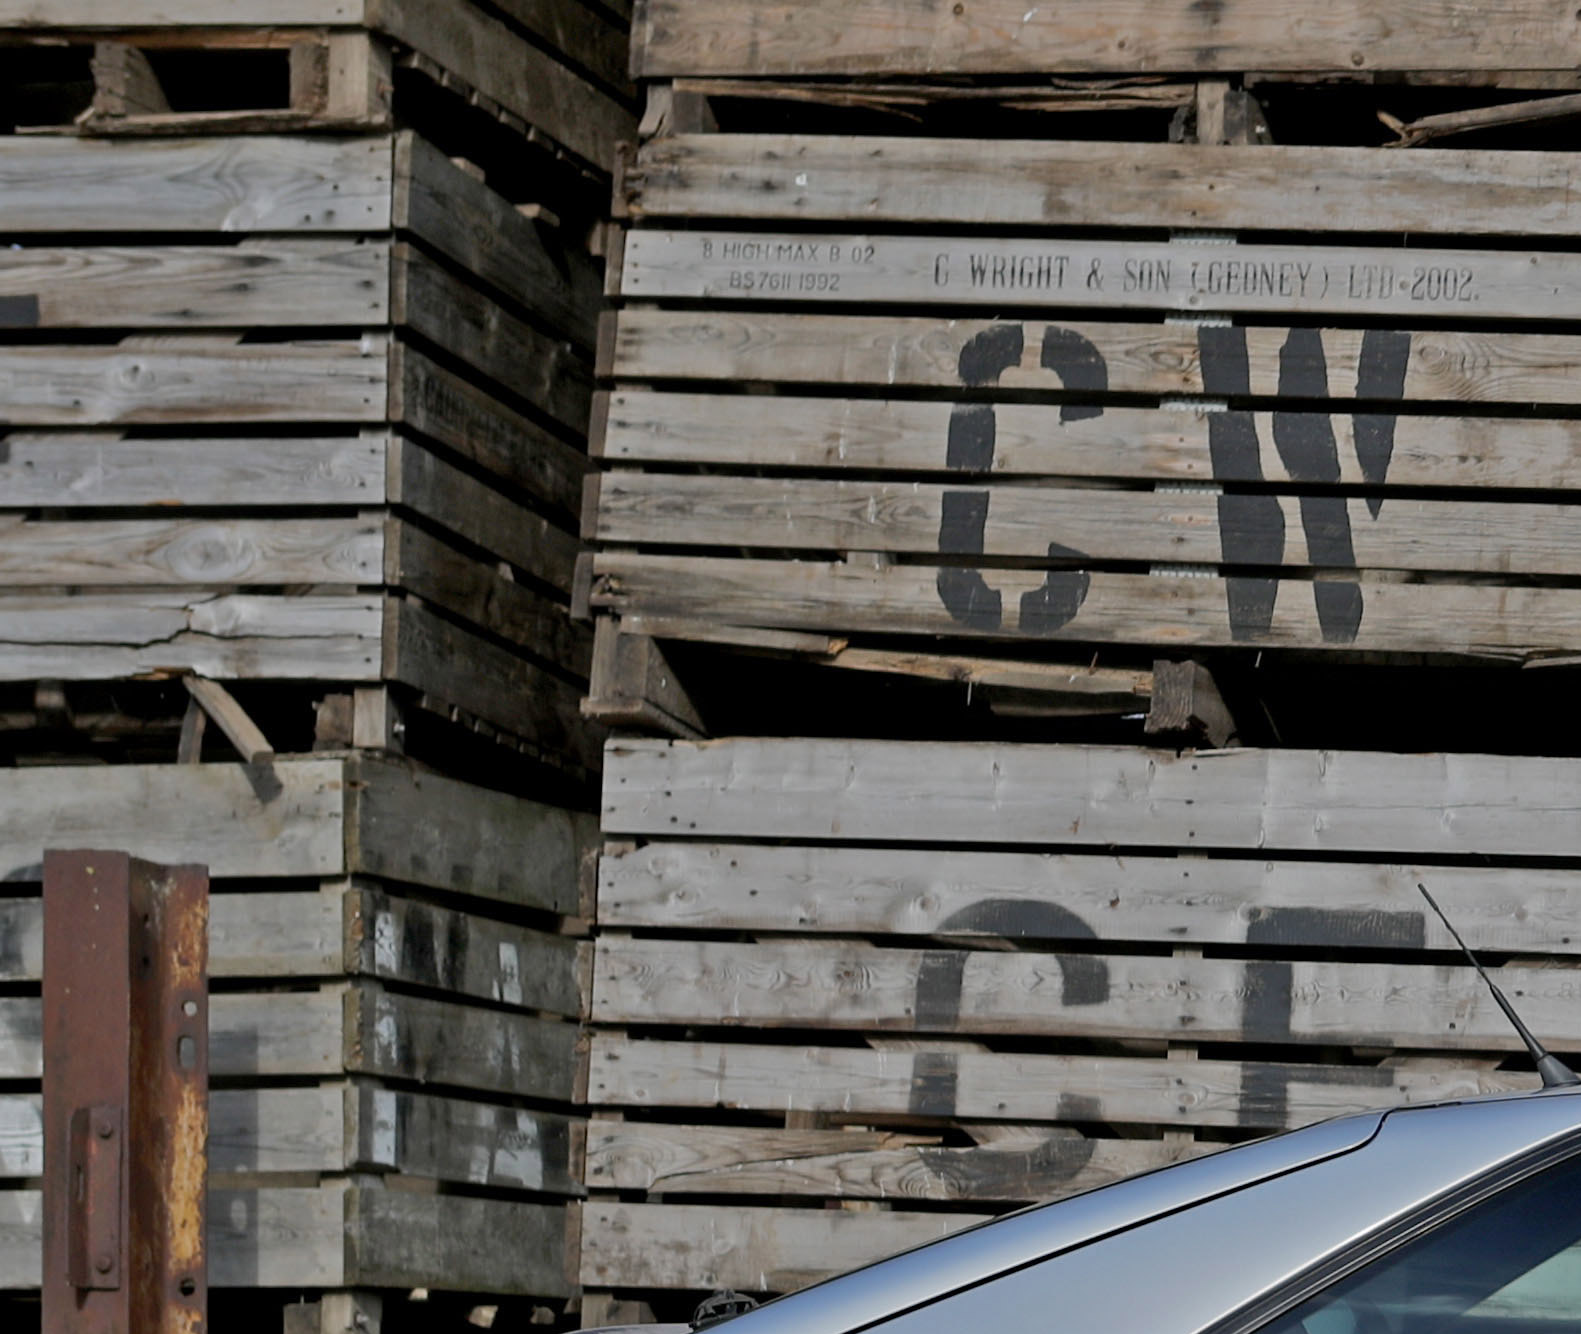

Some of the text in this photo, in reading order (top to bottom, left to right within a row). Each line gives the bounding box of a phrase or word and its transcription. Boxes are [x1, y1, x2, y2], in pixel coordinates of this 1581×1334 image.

[722, 242, 769, 261] HIGH
[776, 244, 818, 262] MAX
[829, 246, 840, 263] B
[851, 245, 875, 264] 02
[799, 273, 841, 292] 1992
[970, 254, 1069, 289] WRIGHT
[1086, 258, 1104, 289] &
[1122, 259, 1171, 292] SON
[1348, 265, 1394, 299] LTD
[937, 324, 1412, 642] CW
